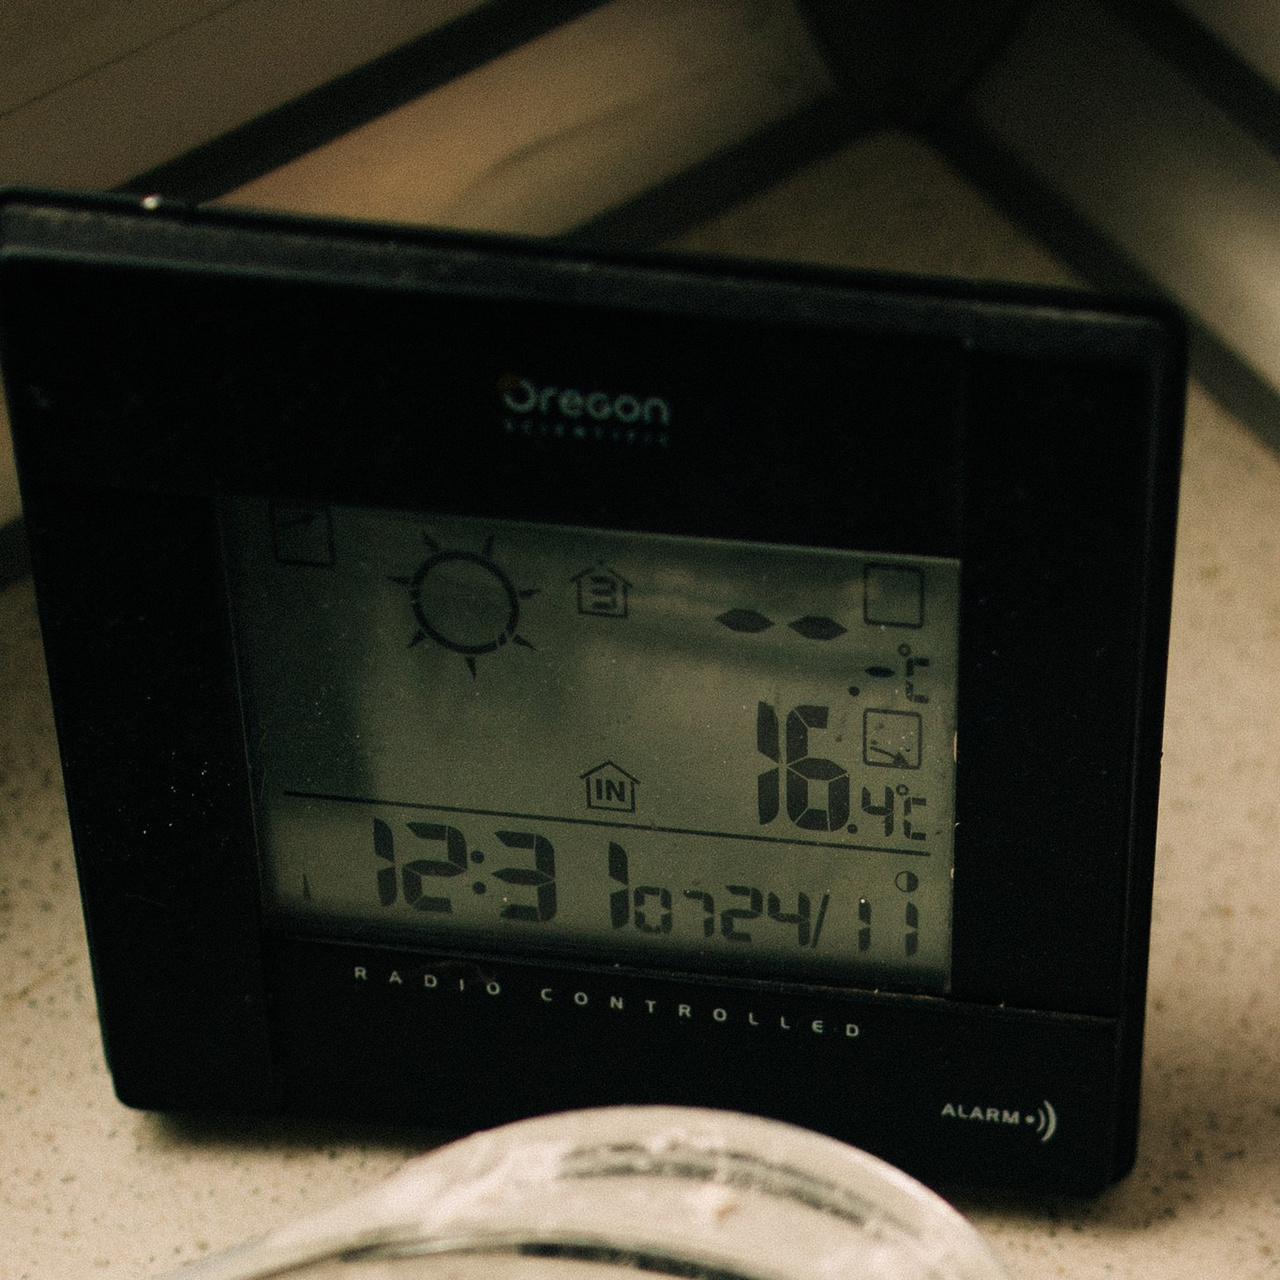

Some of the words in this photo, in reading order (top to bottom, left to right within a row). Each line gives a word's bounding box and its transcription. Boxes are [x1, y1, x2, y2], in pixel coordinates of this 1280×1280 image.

[500, 376, 671, 427] Oregon
[595, 778, 626, 803] IN
[354, 965, 501, 996] RADIO
[540, 987, 860, 1039] CONTROLLED
[940, 1102, 1020, 1125] ALARM
